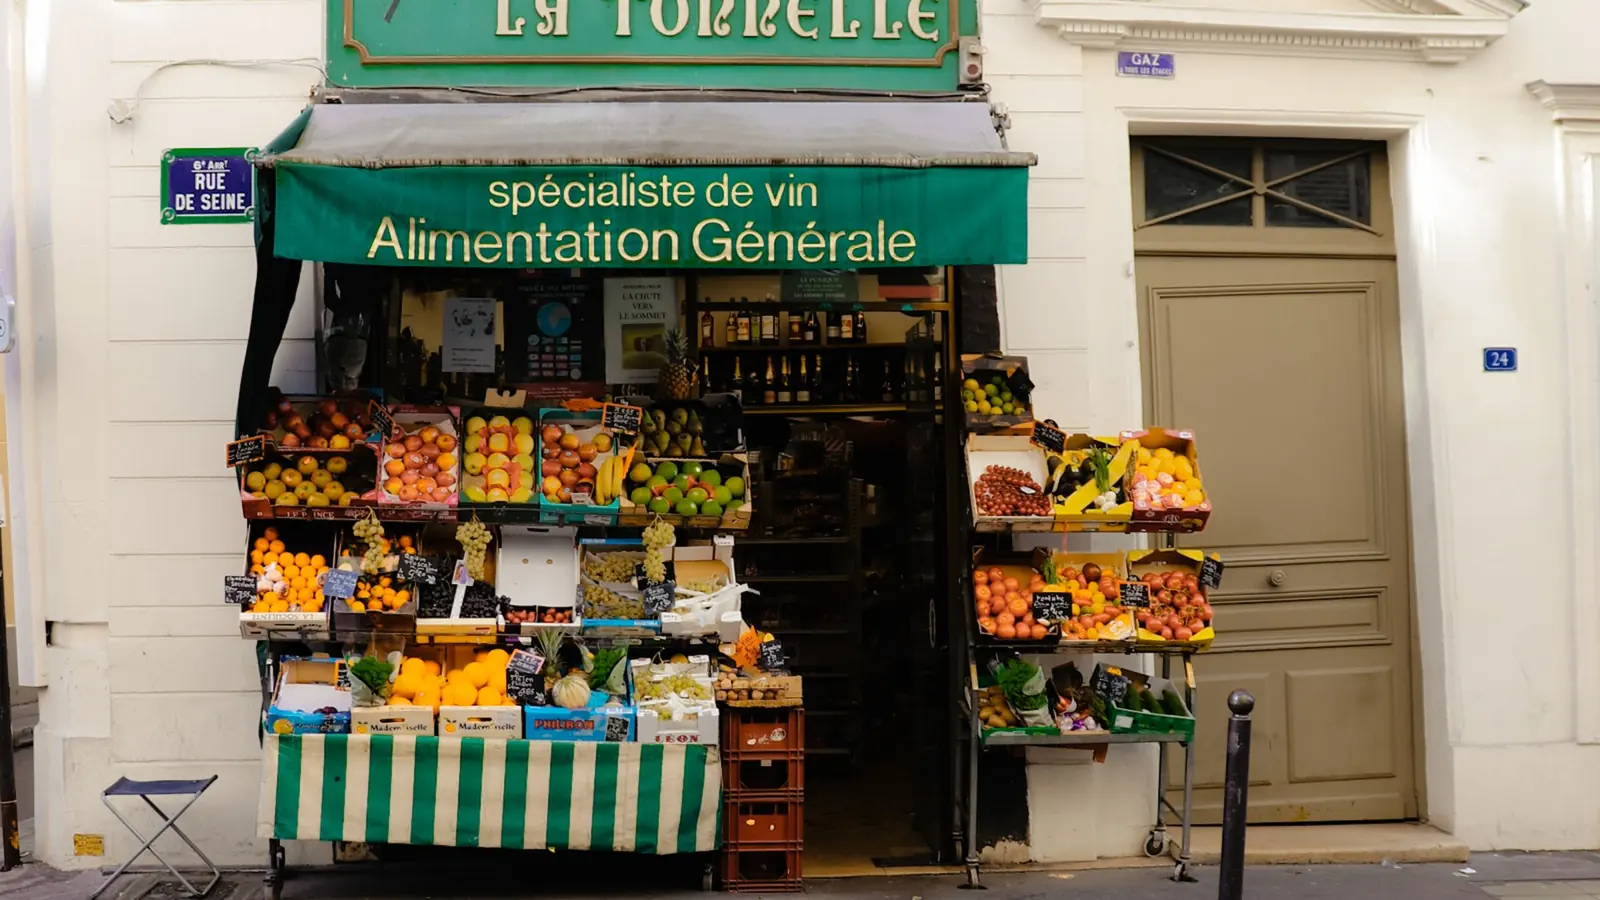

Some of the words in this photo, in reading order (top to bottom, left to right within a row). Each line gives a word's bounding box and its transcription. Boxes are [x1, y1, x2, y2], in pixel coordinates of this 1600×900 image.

[495, 0, 569, 37] LA
[1131, 53, 1160, 66] GAZ
[195, 173, 226, 190] RUE
[488, 172, 696, 216] spécialiste
[705, 173, 754, 208] de
[765, 173, 818, 208] vin
[175, 193, 195, 211] DE
[200, 193, 246, 210] SEINE
[367, 216, 680, 264] Alimentation
[692, 218, 917, 263] Générale
[632, 302, 654, 310] VERS
[619, 312, 630, 320] LE
[631, 311, 666, 320] SOMMET
[1490, 351, 1509, 367] 24
[301, 511, 335, 519] PINCE
[370, 723, 428, 732] Mademiselle
[459, 722, 516, 731] Mademiselle
[534, 719, 595, 730] PHILIBON
